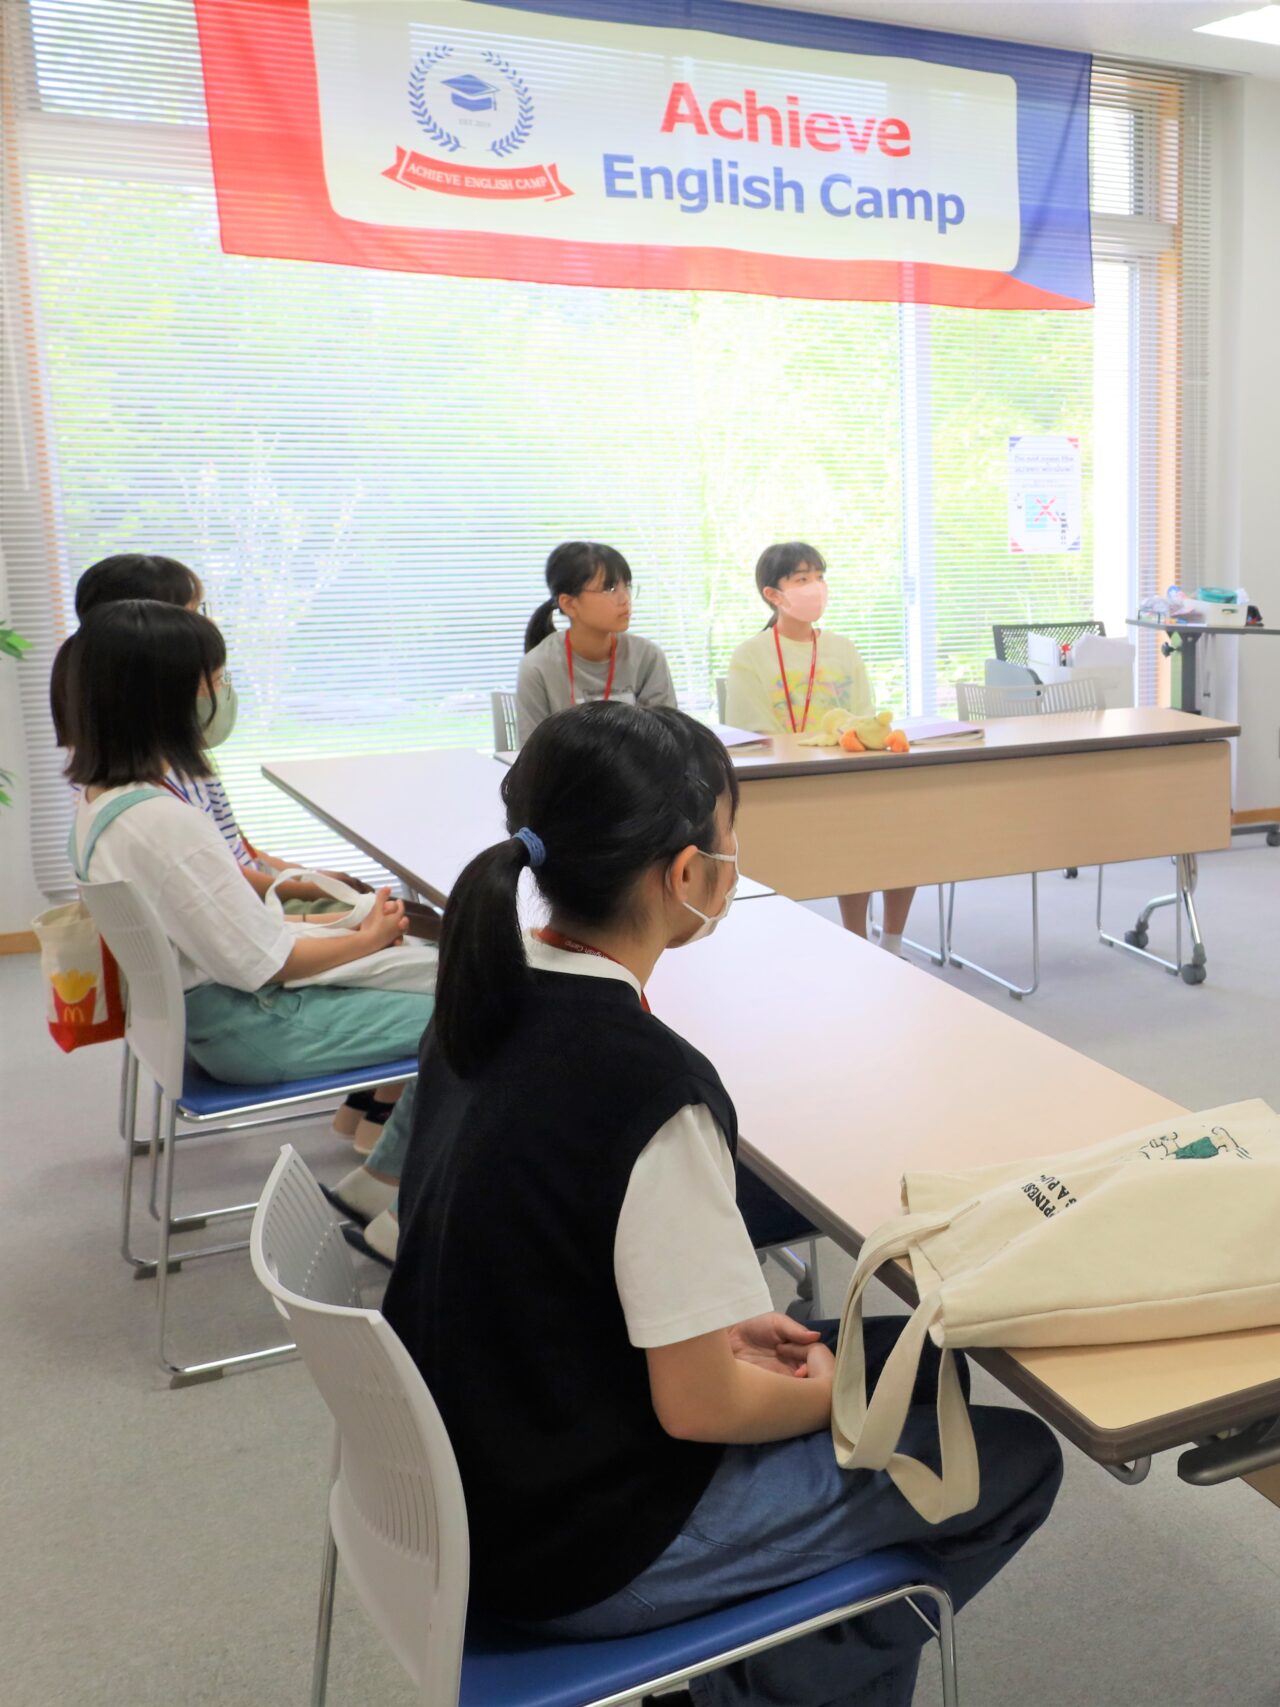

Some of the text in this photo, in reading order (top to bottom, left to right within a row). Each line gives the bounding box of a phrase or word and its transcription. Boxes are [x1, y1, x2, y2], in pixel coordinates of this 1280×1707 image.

[660, 82, 911, 158] Achieve
[407, 163, 548, 190] ACHIEVE ENGLISH CAMP
[602, 153, 965, 234] English Camp
